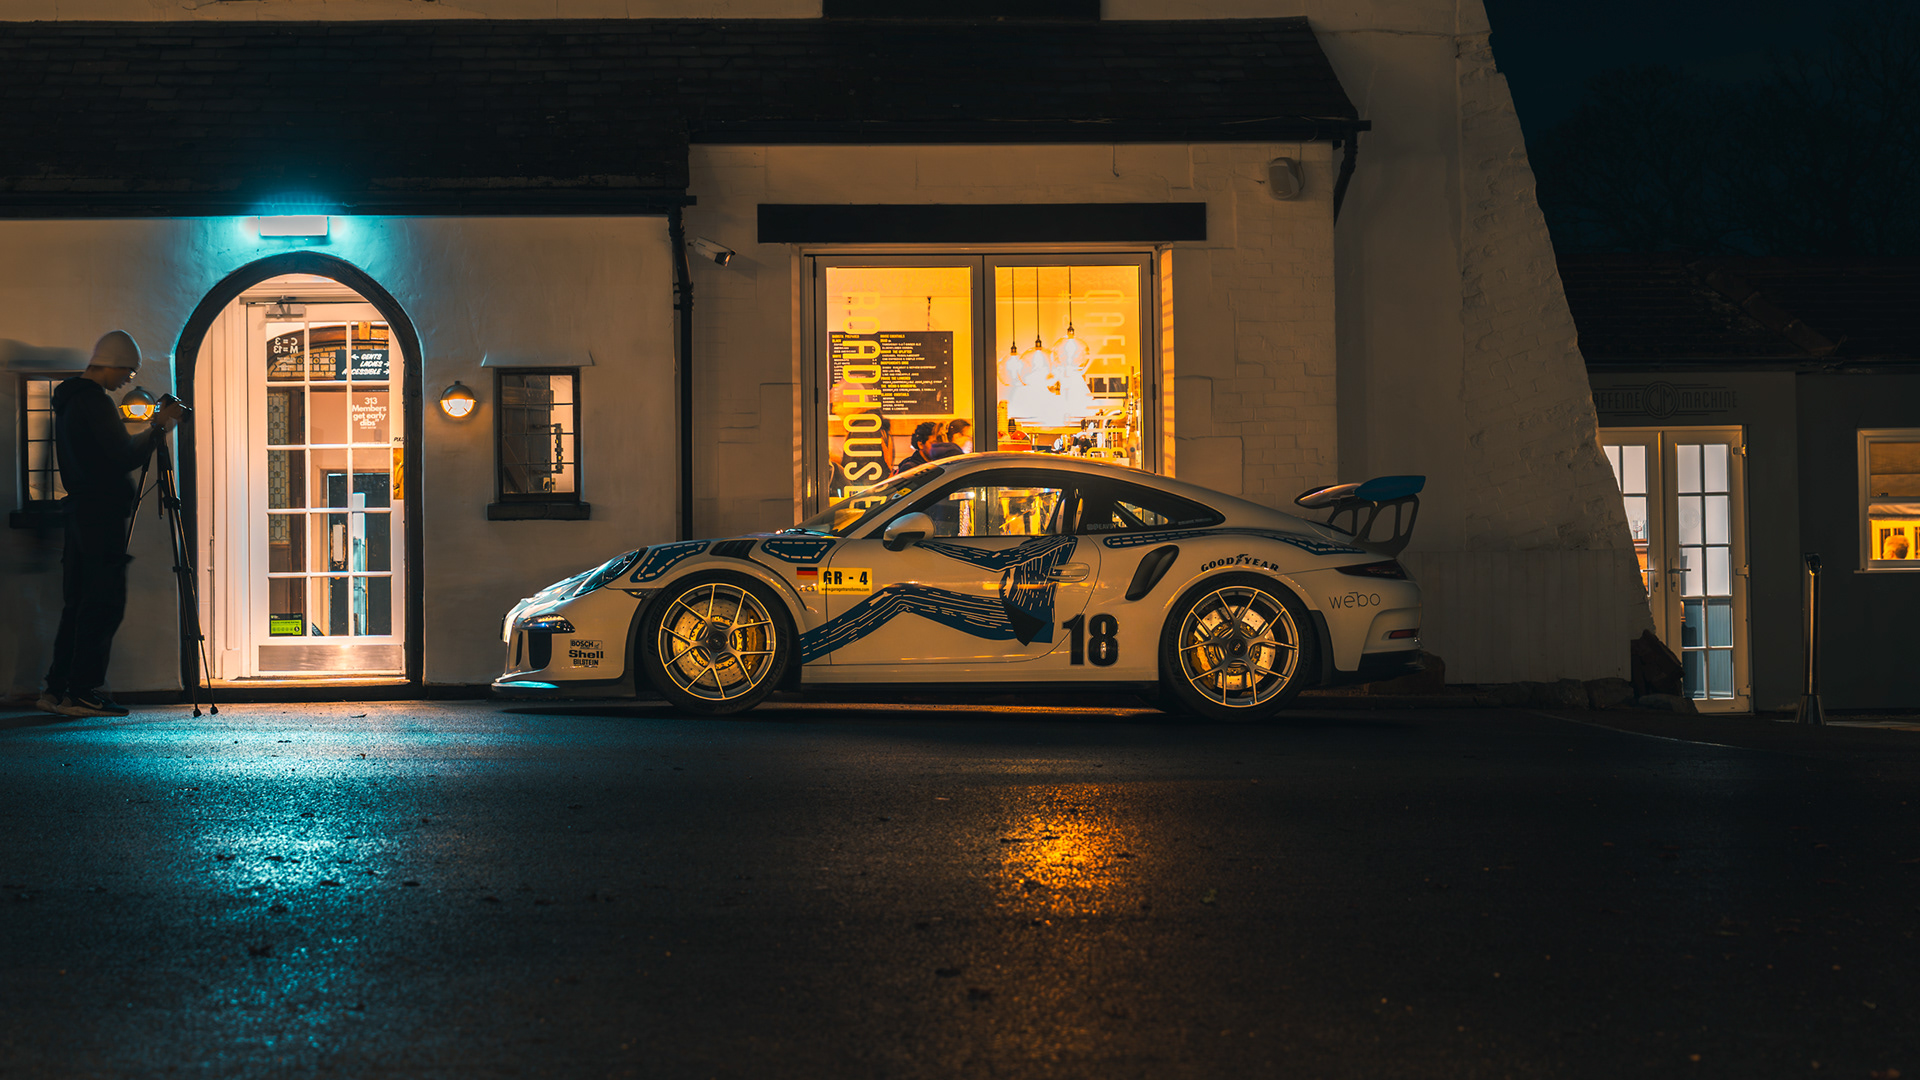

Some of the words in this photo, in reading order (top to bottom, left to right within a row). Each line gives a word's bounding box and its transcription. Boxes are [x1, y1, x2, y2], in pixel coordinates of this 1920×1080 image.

[341, 368, 381, 376] ACESSIBLE
[364, 397, 378, 405] 313
[842, 291, 886, 509] ROADHOUSE
[1593, 392, 1641, 409] AFFEINE
[1681, 390, 1738, 408] MACHINE
[351, 404, 387, 412] Members
[353, 412, 366, 422] get
[366, 411, 386, 421] early
[823, 570, 842, 585] GR
[859, 571, 868, 585] 4
[1328, 591, 1381, 609] webo
[1062, 613, 1119, 667] 18
[568, 649, 604, 659] Shell
